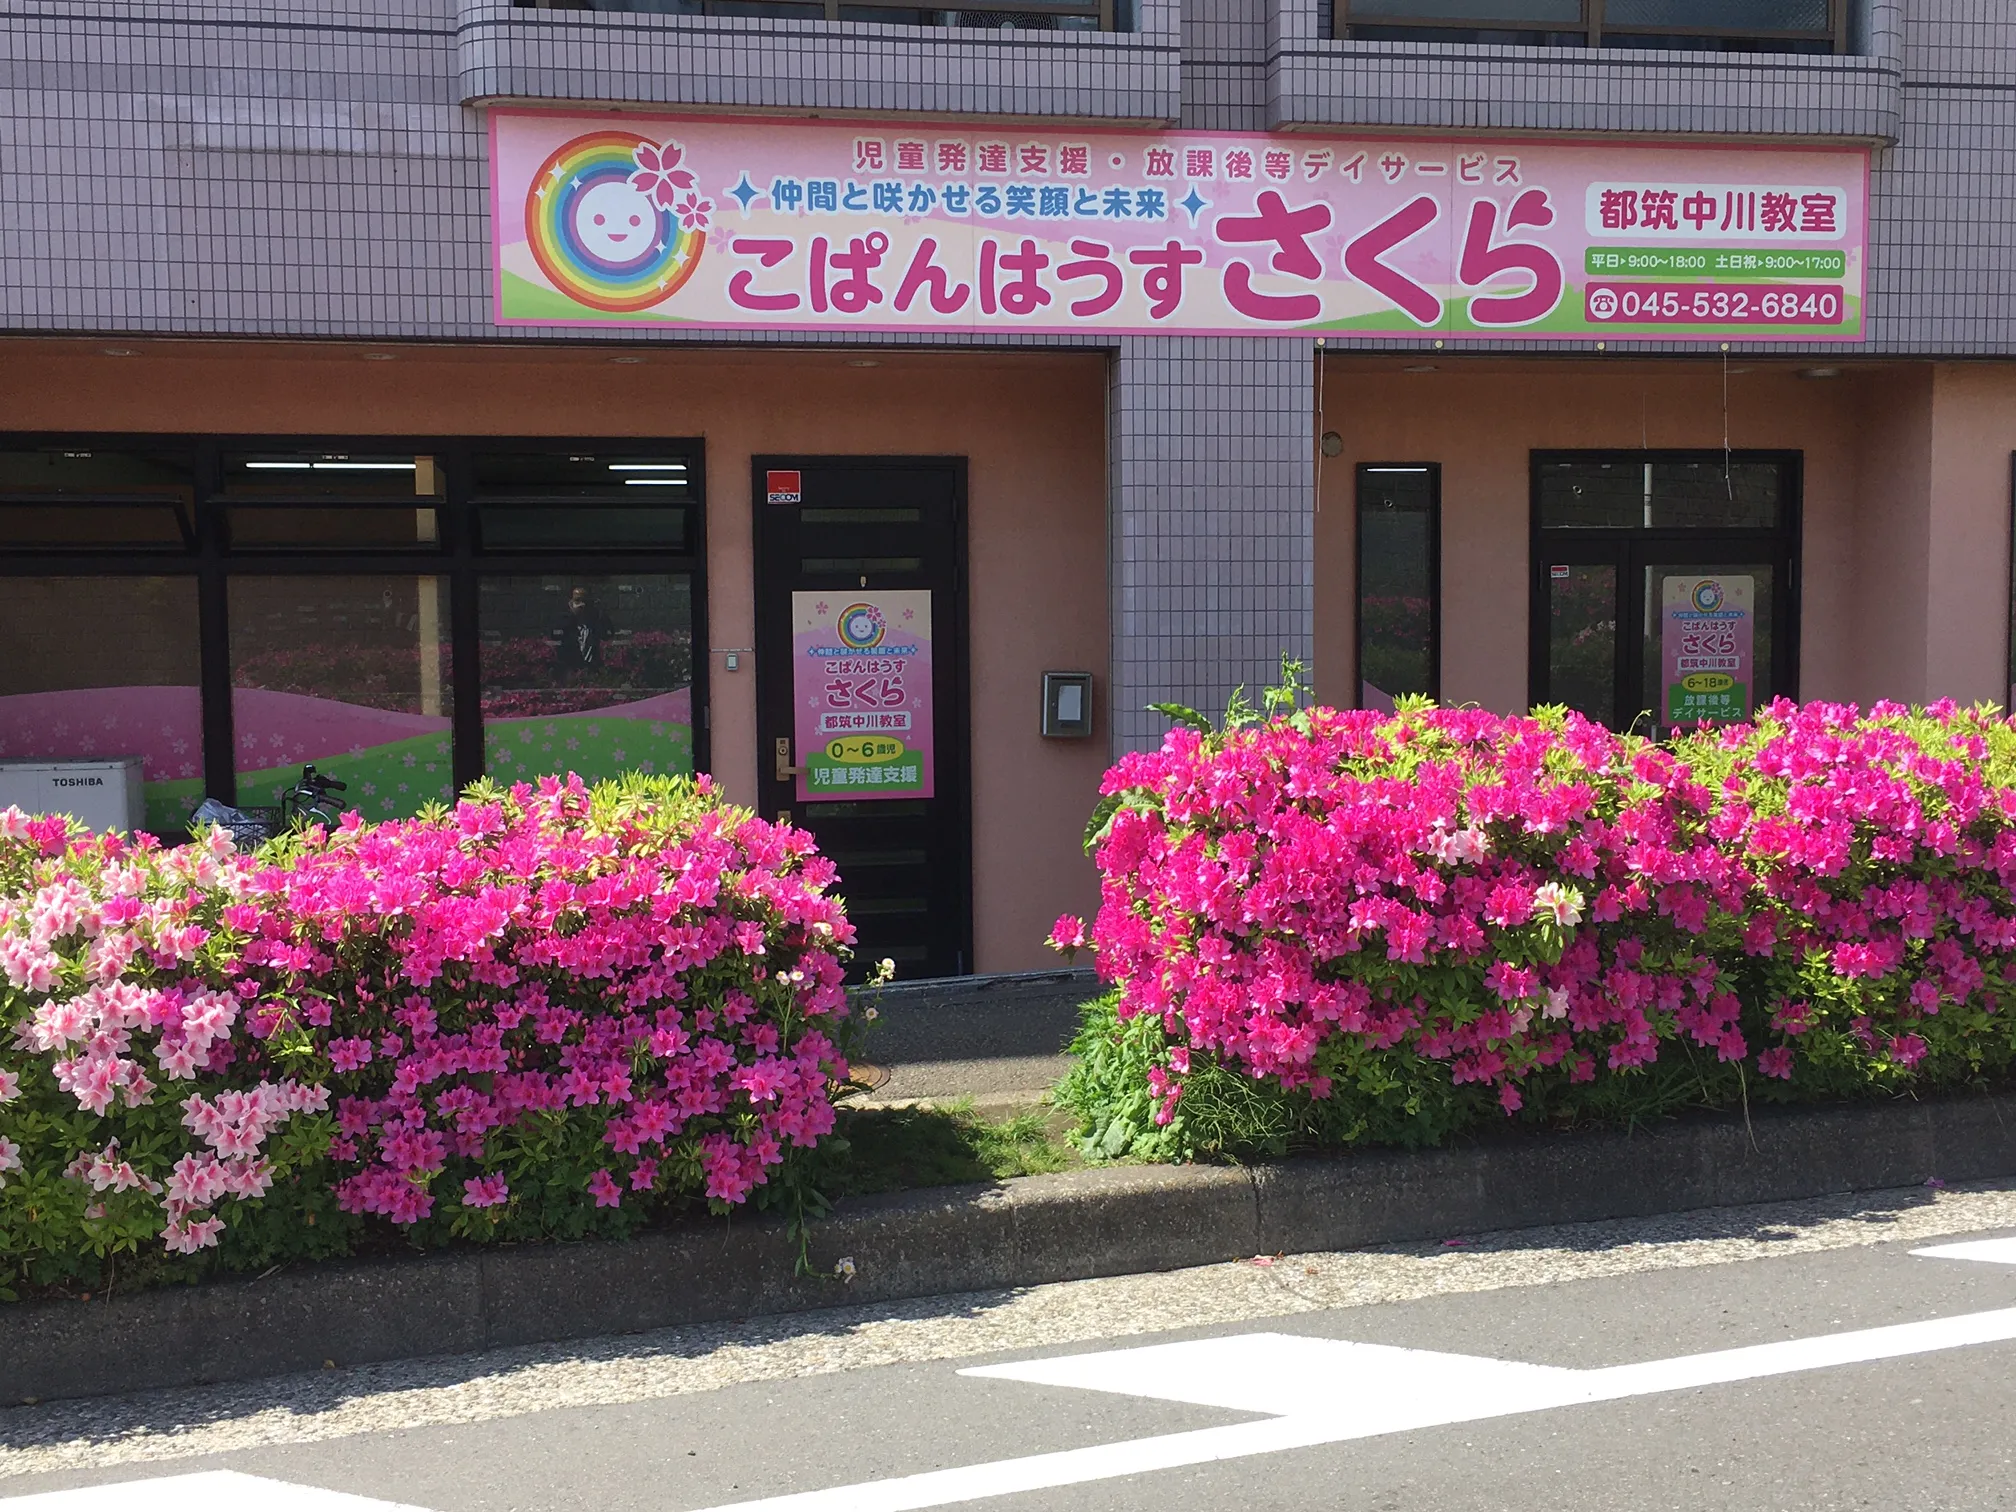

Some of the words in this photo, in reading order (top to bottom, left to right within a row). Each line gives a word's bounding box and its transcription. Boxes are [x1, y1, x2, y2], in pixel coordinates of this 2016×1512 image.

[771, 178, 1165, 219] 仲間と咲かせる笑顔と未来
[1599, 189, 1837, 233] 都筑中川教室
[726, 230, 1202, 320] こぱんはうす
[1215, 189, 1566, 325] さくら
[1622, 291, 1837, 318] 045-532-6840
[1683, 633, 1735, 654] さくら
[826, 676, 905, 706] さくら
[825, 714, 906, 729] 都筑中川教室
[53, 778, 103, 787] TOSHIBA
[814, 765, 917, 785] 児童発達支援
